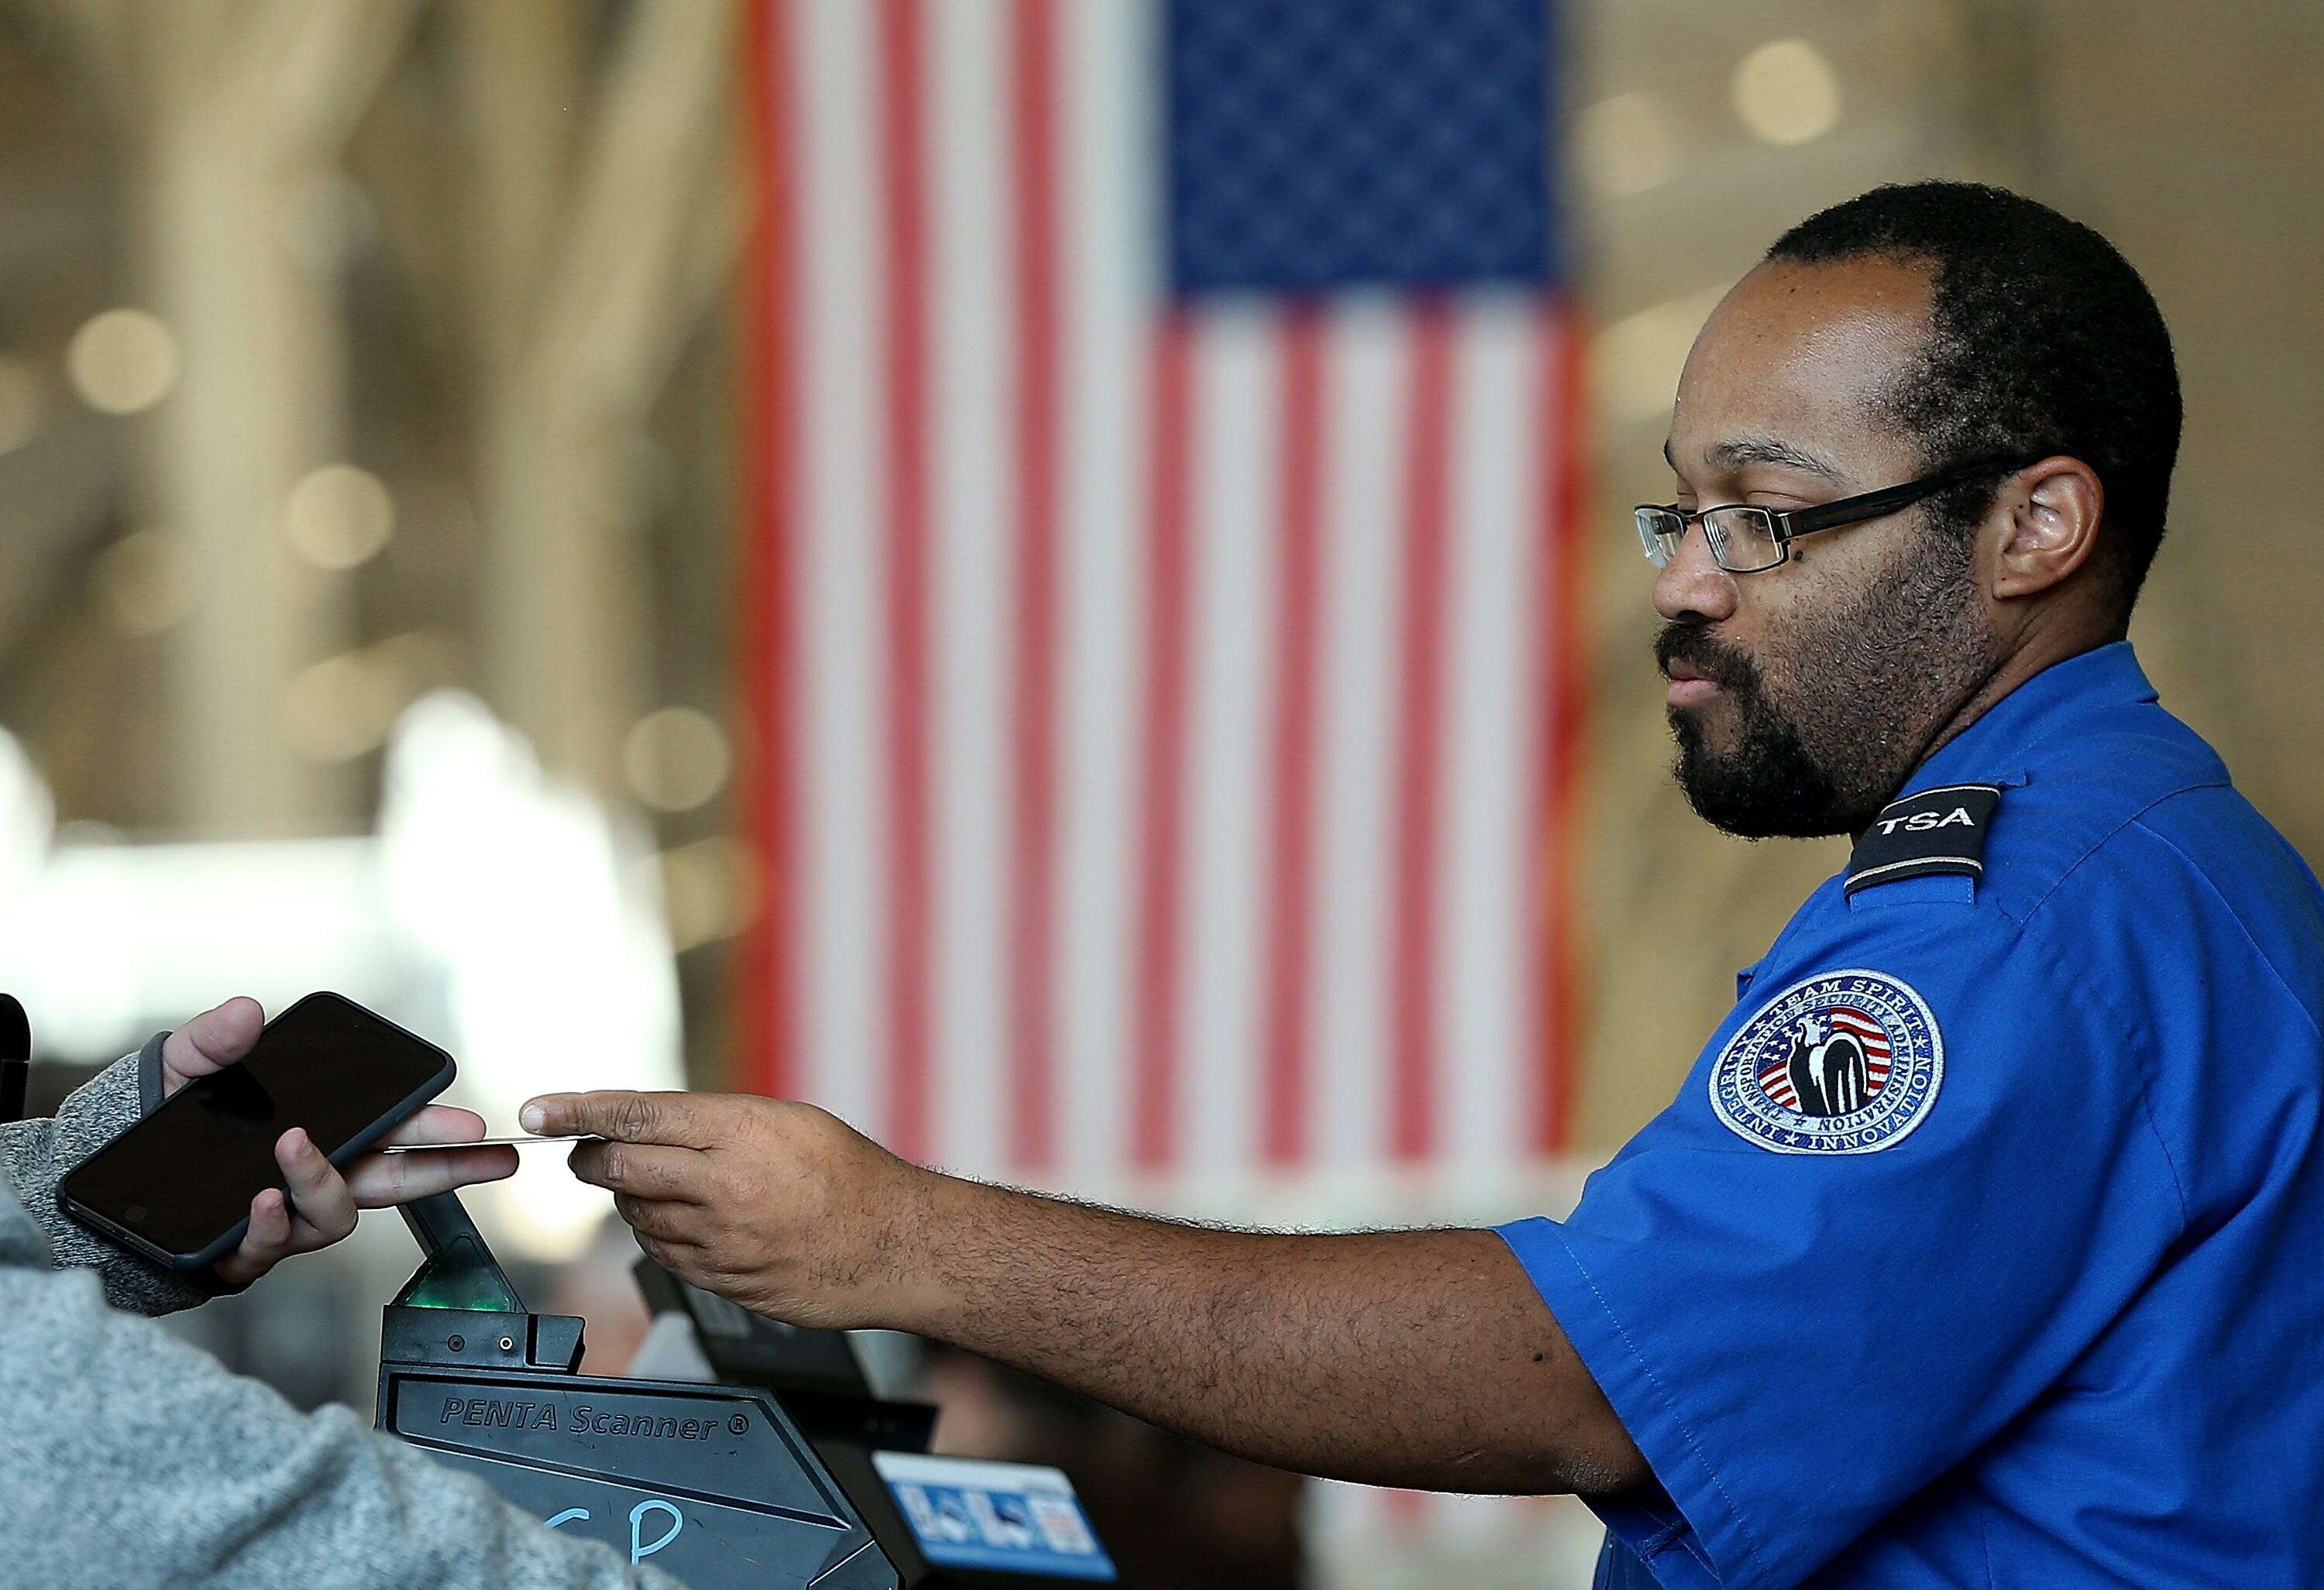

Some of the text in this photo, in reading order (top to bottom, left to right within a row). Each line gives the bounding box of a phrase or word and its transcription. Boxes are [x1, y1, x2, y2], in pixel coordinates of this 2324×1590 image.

[1876, 807, 1975, 835] TSA
[1769, 980, 1923, 1031] TEAM SPIRIT
[1720, 1035, 1780, 1139] INTEGRITY
[1808, 1055, 1931, 1150] INNOVATION
[440, 1397, 558, 1430] PENTA
[569, 1405, 718, 1441] Scanner
